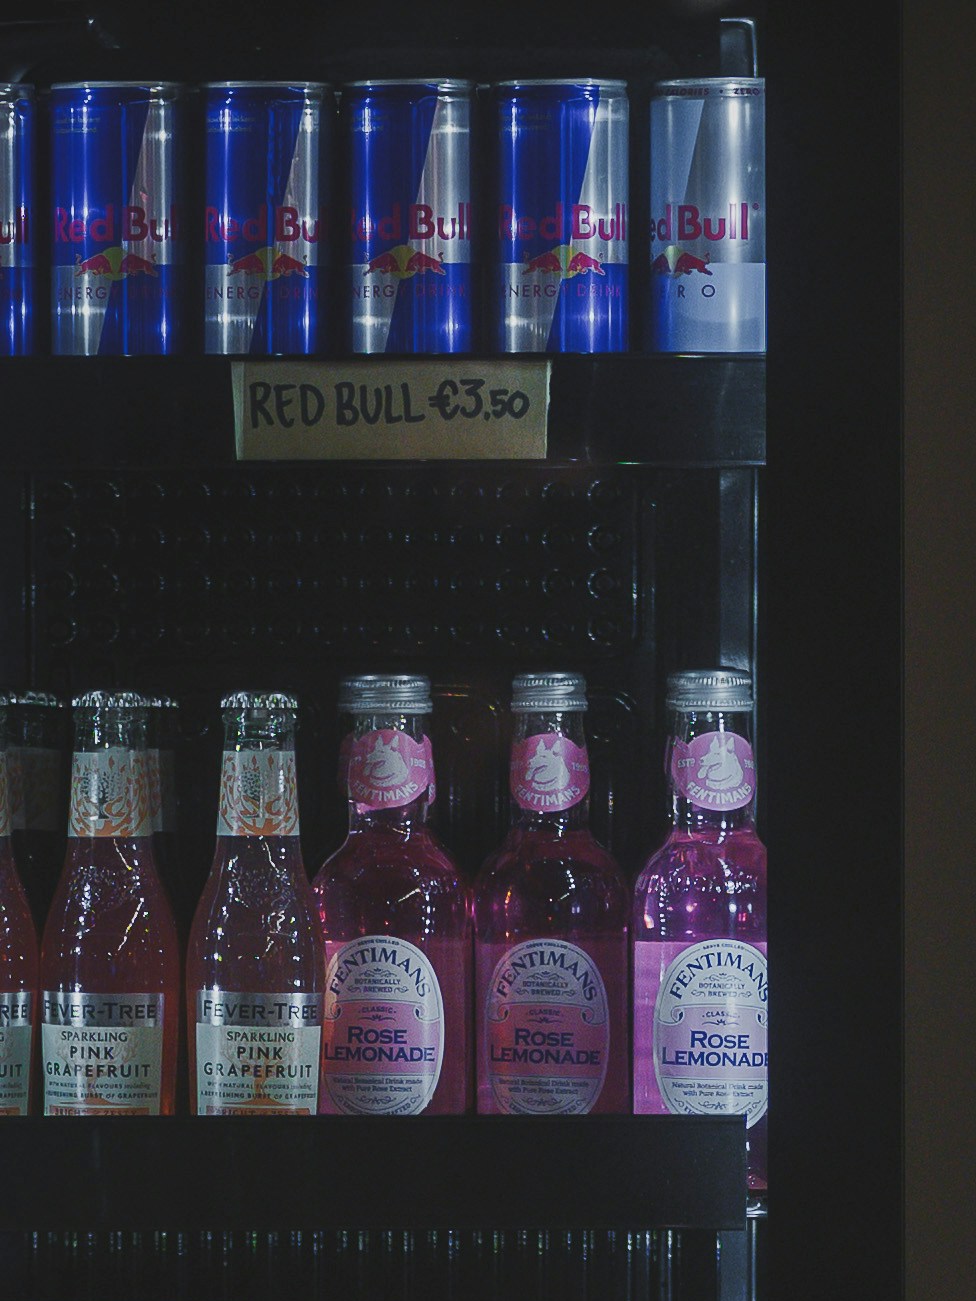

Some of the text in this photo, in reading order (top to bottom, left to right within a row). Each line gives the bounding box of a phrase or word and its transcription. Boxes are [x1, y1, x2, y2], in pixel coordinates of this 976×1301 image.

[0, 207, 29, 244] ull
[55, 205, 114, 243] Red
[205, 205, 267, 243] Red
[408, 203, 471, 241] Bull
[571, 203, 626, 241] Bull
[651, 203, 749, 241] ed Bull
[249, 378, 531, 429] RED BULL €3.50
[514, 783, 581, 806] FENTIMANS
[686, 781, 752, 804] FENTIMANS
[329, 946, 432, 998] FENTIMANS
[354, 978, 401, 986] BOTANICALLY
[496, 950, 598, 1003] FENTIMANS
[669, 952, 768, 1003] FENTIMANS
[522, 980, 568, 989] BOTANICALLY
[44, 1003, 157, 1020] FEVER-TREE
[203, 1000, 318, 1020] FEVER-TREE
[60, 1030, 128, 1043] SPARKLING
[226, 1030, 295, 1043] SPARKLING
[347, 1025, 408, 1046] ROSE
[514, 1027, 574, 1047] ROSE
[690, 1030, 750, 1050] ROSE
[69, 1046, 115, 1060] PINK
[236, 1046, 283, 1061] PINK
[324, 1042, 436, 1064] LEMONADE
[490, 1044, 601, 1066] LEMONADE
[46, 1062, 152, 1079] GRAPEFRUIT
[203, 1061, 313, 1079] GRAPEFRUIT
